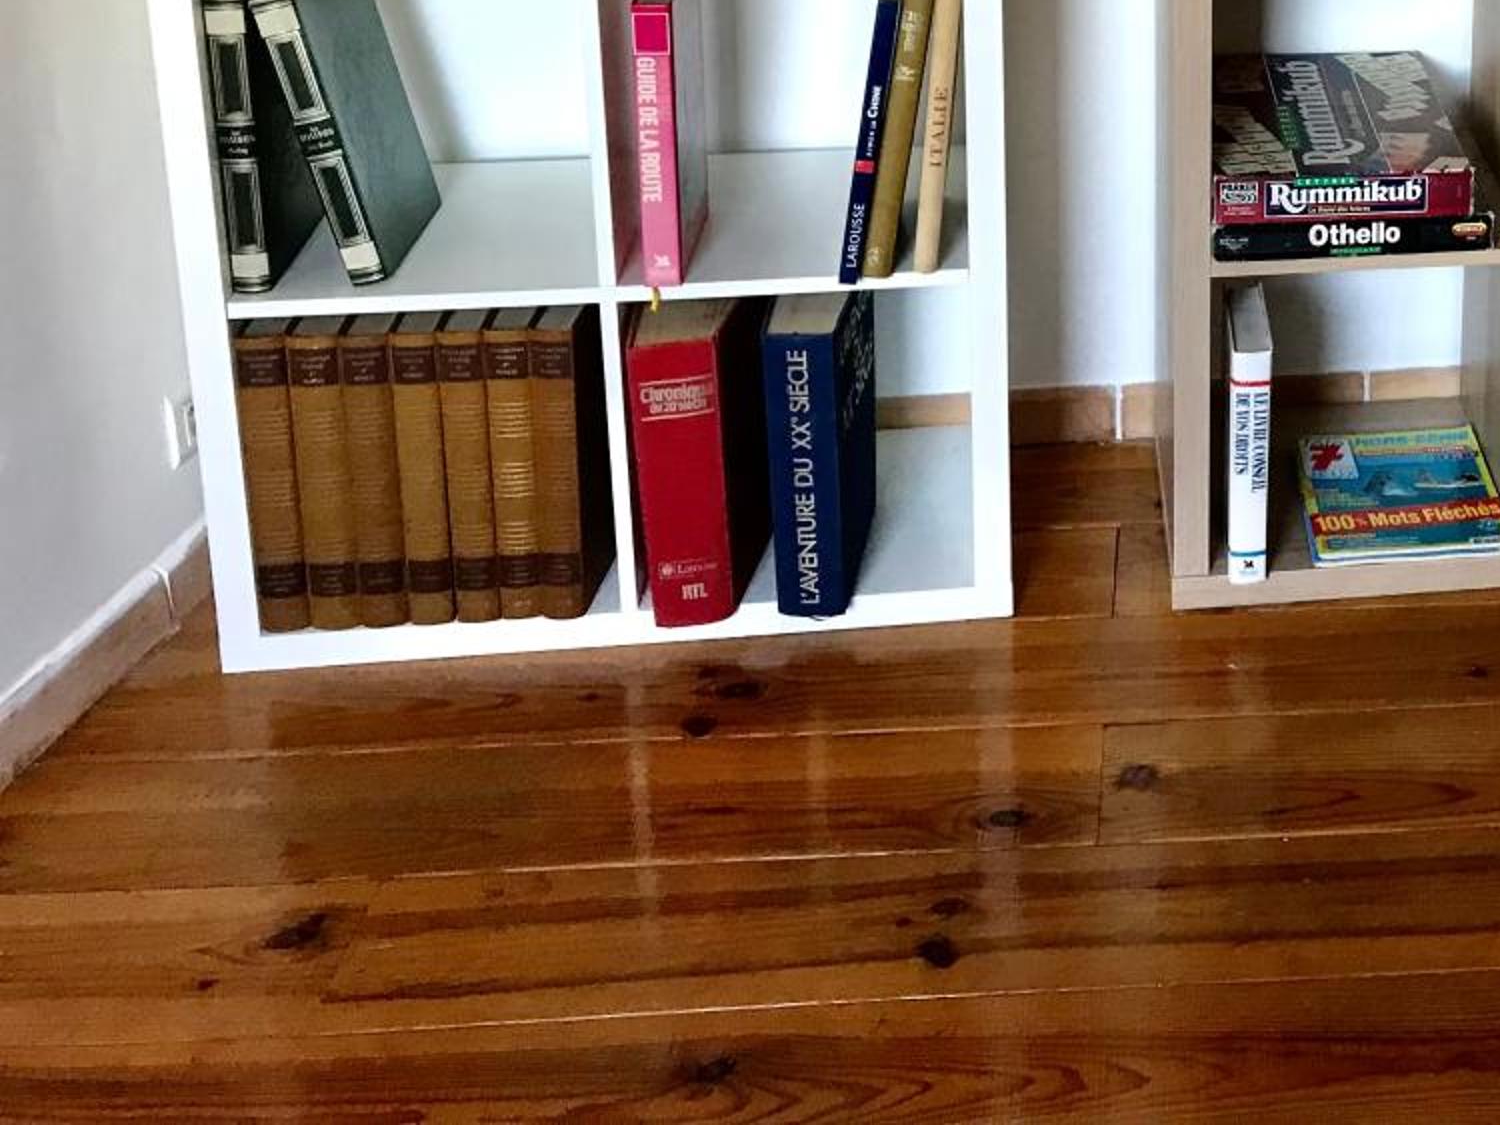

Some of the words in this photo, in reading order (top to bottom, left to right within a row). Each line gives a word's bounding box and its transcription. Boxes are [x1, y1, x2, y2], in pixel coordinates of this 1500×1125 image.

[636, 57, 658, 105] GUIDE
[639, 106, 659, 127] DE
[930, 86, 949, 168] ITALIE
[640, 130, 660, 150] LA
[641, 152, 663, 204] ROUTE
[1269, 178, 1423, 214] Rummikub
[845, 203, 865, 268] LAROUSSE
[1309, 221, 1400, 247] Othello
[793, 457, 814, 488] DU
[1368, 508, 1421, 529] Mots
[795, 493, 821, 605] L'AVENTURE
[681, 582, 709, 600] RTL
